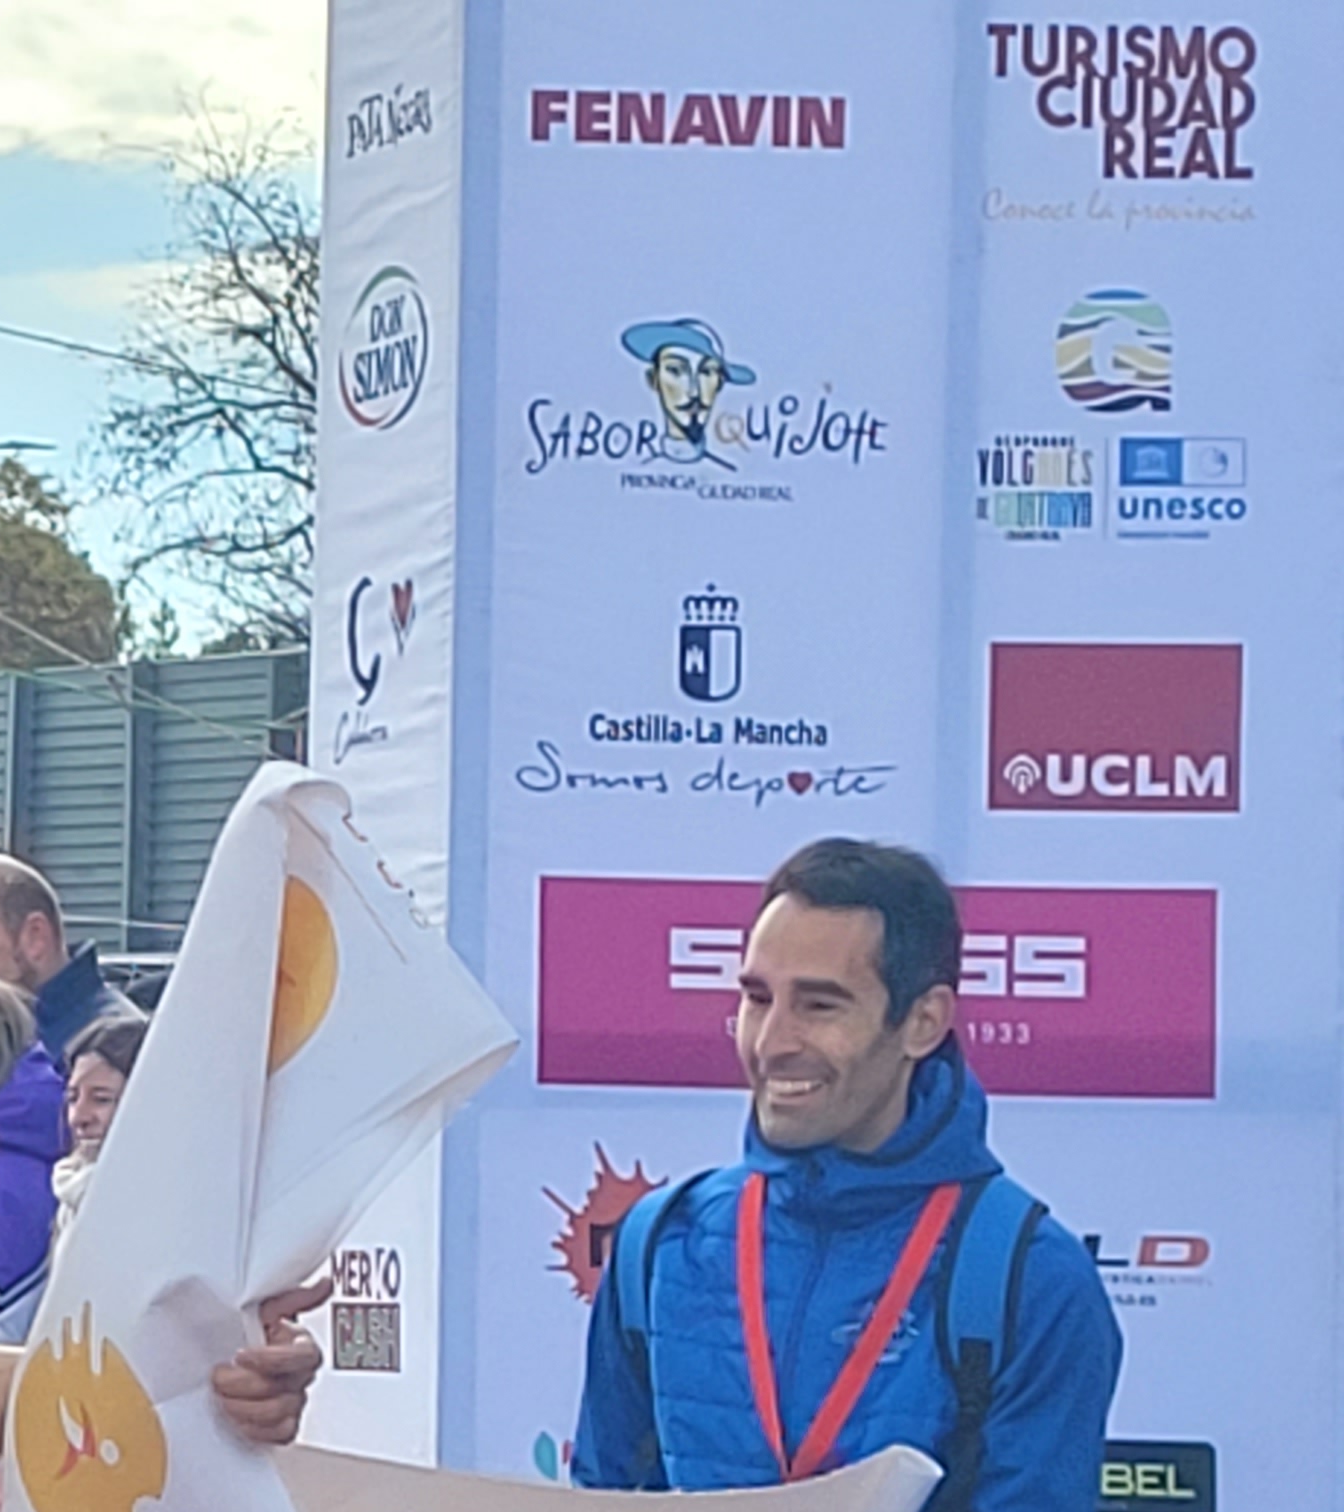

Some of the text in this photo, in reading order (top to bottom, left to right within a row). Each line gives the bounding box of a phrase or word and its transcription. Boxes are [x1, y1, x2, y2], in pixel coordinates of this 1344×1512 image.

[986, 23, 1257, 80] TURISMO
[531, 90, 846, 149] FENAVIN
[1036, 70, 1257, 130] CIUDAD
[1102, 122, 1254, 180] REAL
[525, 398, 661, 475] SABOR
[1118, 497, 1247, 521] unesco
[734, 718, 828, 747] Mancha
[1045, 755, 1229, 798] UCLM
[669, 927, 1087, 999] SSS
[966, 1022, 1031, 1045] 1933
[1082, 1233, 1211, 1268] LD
[336, 1306, 398, 1369] CASH
